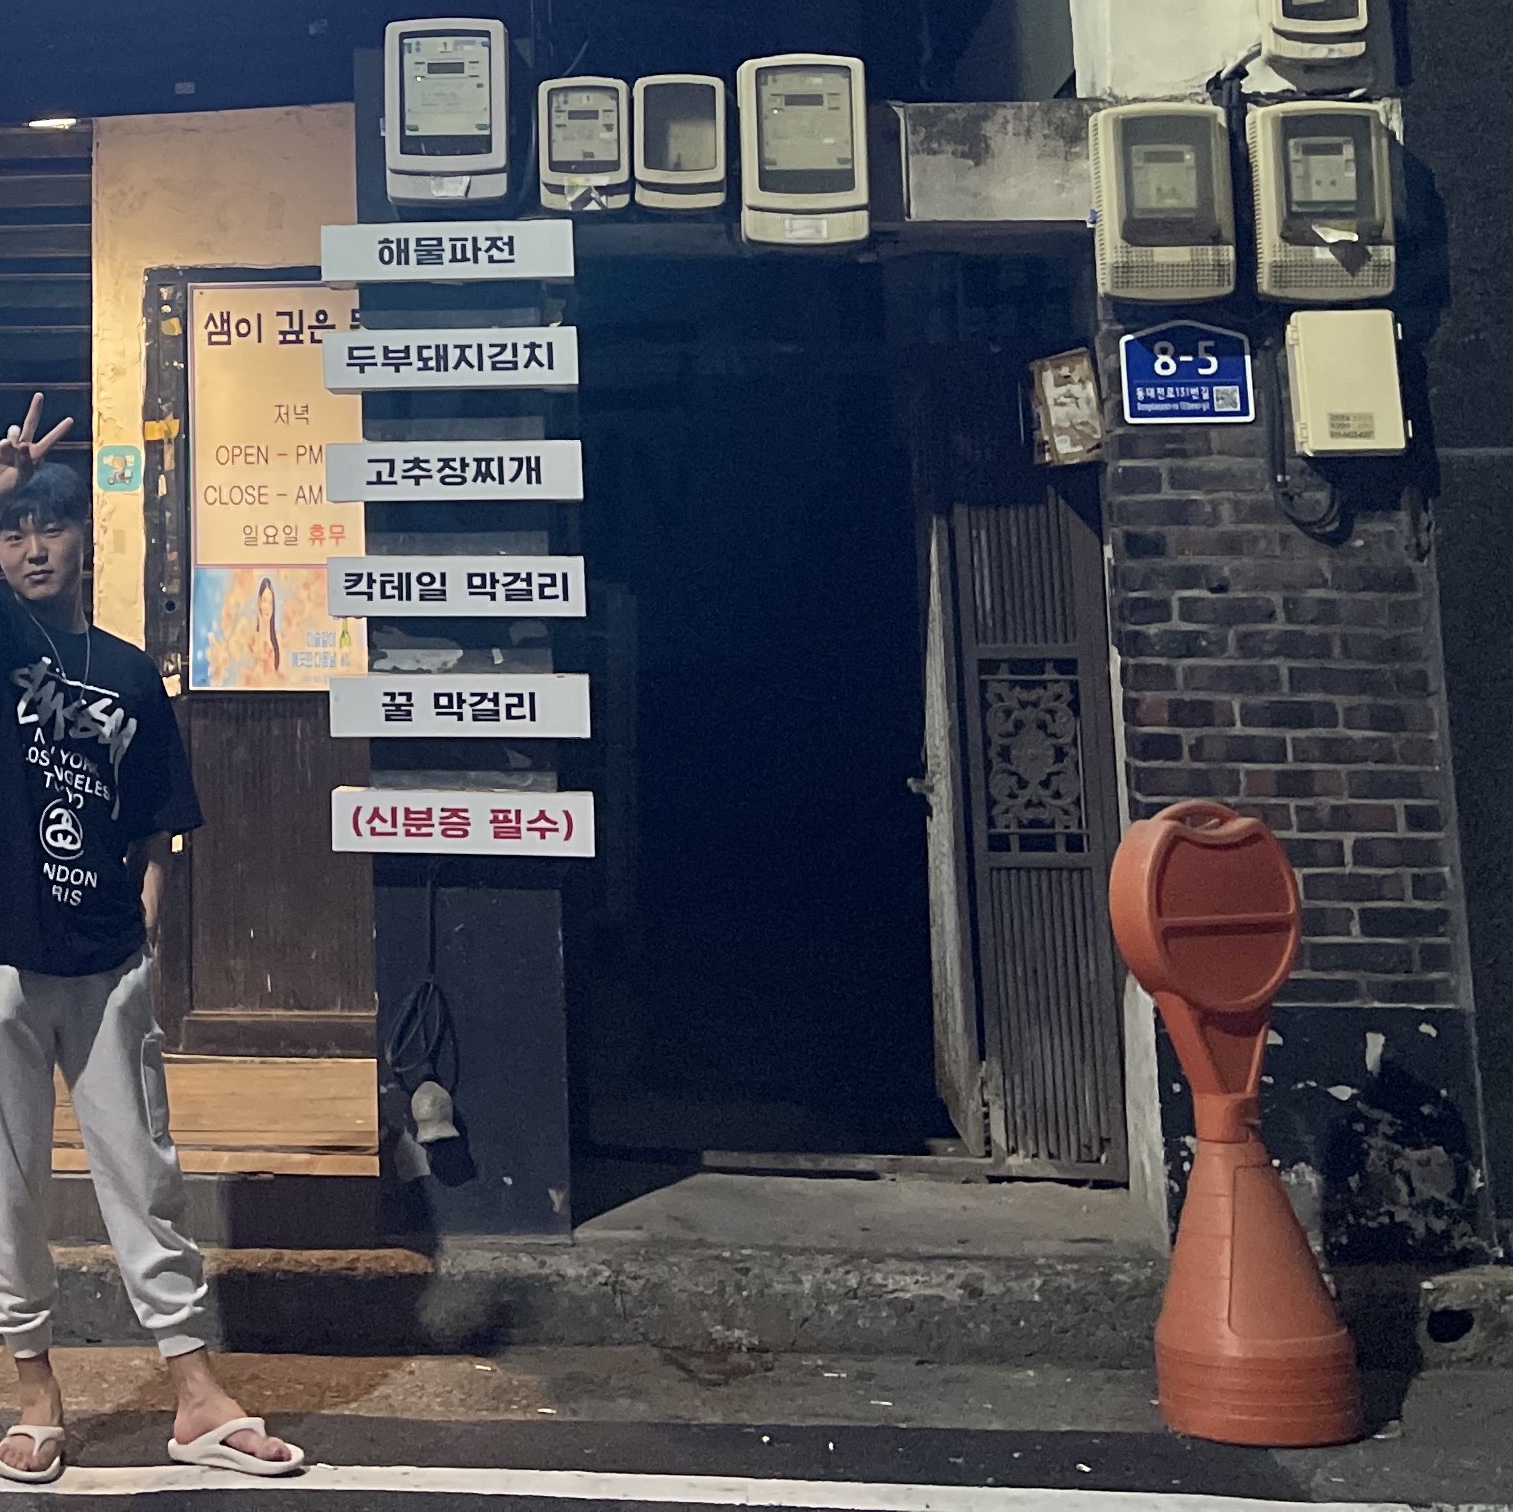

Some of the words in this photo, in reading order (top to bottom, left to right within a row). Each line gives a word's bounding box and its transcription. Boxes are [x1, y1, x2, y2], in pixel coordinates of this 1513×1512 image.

[377, 235, 516, 266] 해물파전
[204, 310, 263, 346] 샘이
[275, 309, 337, 345] 깊은
[345, 341, 555, 375] 두부돼지김치
[1153, 340, 1219, 376] 8-5
[273, 403, 310, 426] 저녁
[215, 444, 269, 466] OPEN
[296, 444, 323, 465] PM
[365, 455, 542, 487] 고추장찌개
[203, 484, 270, 506] CLOSE
[294, 484, 323, 505] AM
[242, 524, 299, 547] 일요일
[308, 524, 347, 546] 휴무
[344, 571, 448, 602] 칵테일
[466, 571, 570, 602] 막걸리
[381, 691, 415, 722] 꿀
[433, 691, 537, 723] 막걸리
[352, 805, 472, 839] (신분증
[489, 808, 574, 842] 필수)
[43, 862, 98, 889] NDON
[51, 884, 84, 907] RIS
